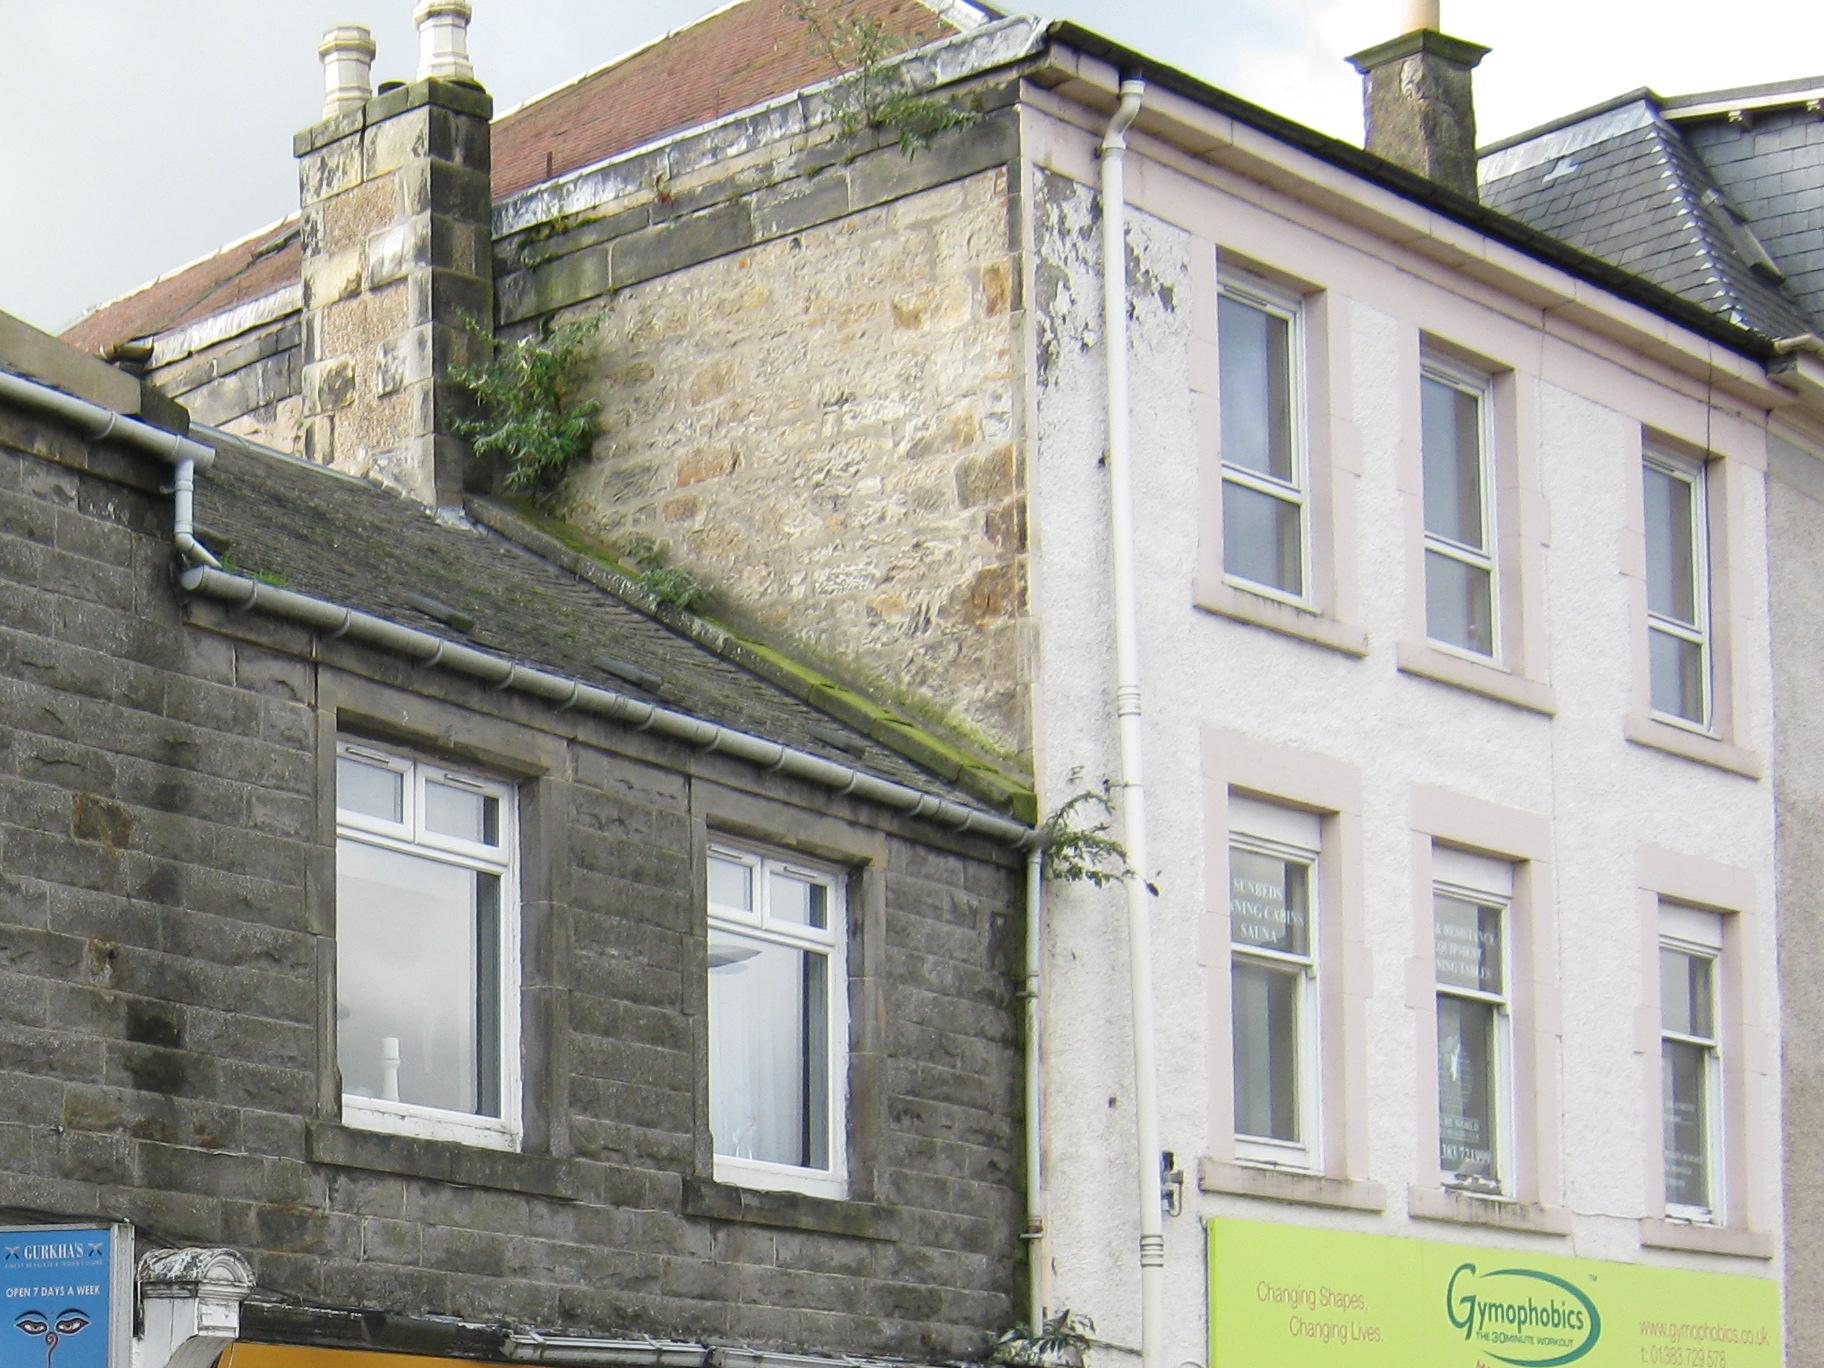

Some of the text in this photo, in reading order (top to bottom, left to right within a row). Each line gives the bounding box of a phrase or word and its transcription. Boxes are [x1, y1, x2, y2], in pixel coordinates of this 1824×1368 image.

[24, 1242, 84, 1260] GURKHA'S
[6, 1285, 100, 1298] OPEN 7 DAYS A WEEK
[1257, 1280, 1369, 1312] Changing Shapes,
[1446, 1263, 1584, 1341] Gymophobics
[1289, 1316, 1385, 1346] Changing Lives.
[1640, 1320, 1770, 1346] www.gymophobics.co.uk
[1651, 1346, 1683, 1366] 01383
[1707, 1350, 1726, 1368] 578
